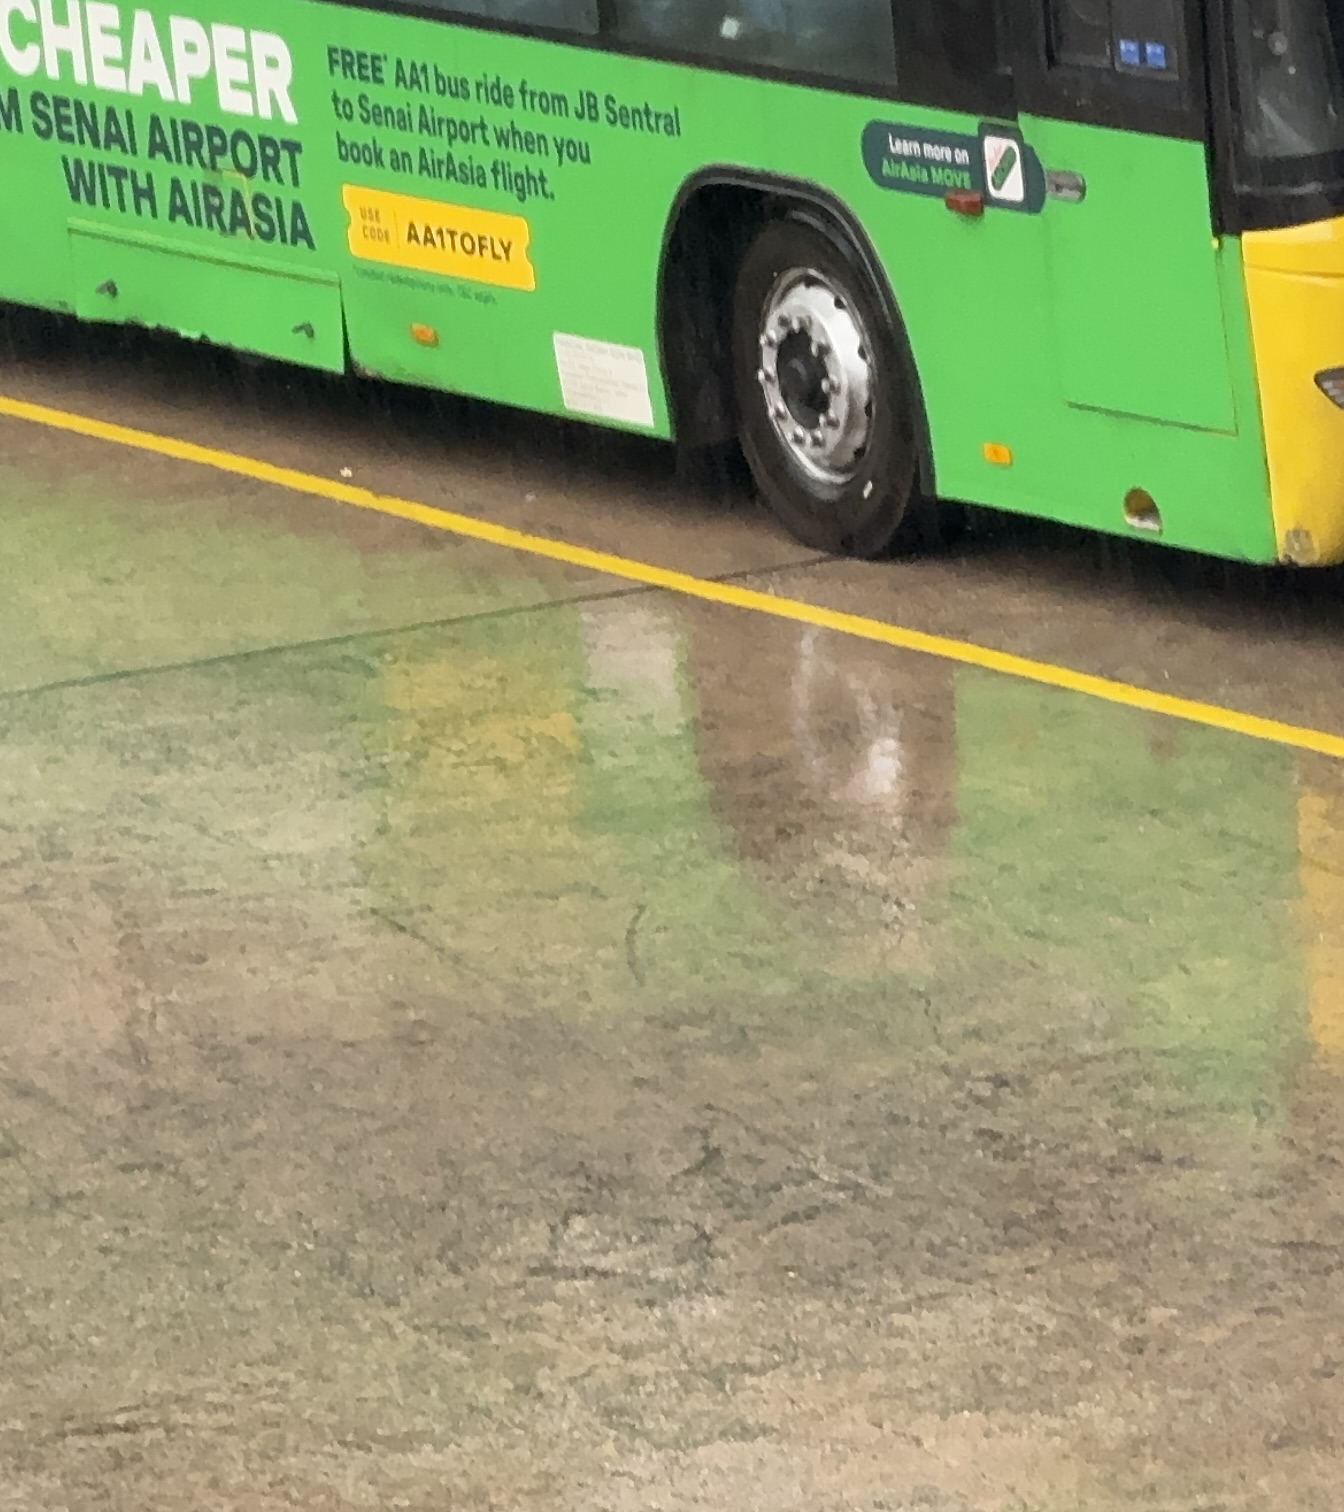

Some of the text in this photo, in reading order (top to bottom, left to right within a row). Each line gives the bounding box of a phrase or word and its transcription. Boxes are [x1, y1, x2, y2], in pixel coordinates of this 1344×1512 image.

[394, 57, 431, 93] AA1
[433, 64, 471, 102] bus
[475, 73, 515, 110] ride
[518, 79, 570, 118] from
[574, 90, 600, 123] JB
[605, 95, 681, 137] Sentral
[29, 90, 138, 157] SENAI
[147, 114, 303, 189] AIRPORT
[331, 89, 592, 167] to Senai Airport when you
[888, 132, 970, 166] Learn more on
[335, 130, 556, 203] book an AirAsia flight.
[881, 157, 929, 183] AirAsia
[931, 165, 972, 189] MOVE
[60, 155, 317, 251] WITH AIRASIA
[359, 206, 381, 224] USE
[362, 224, 391, 245] CODE
[406, 220, 513, 263] AA1TOFLY
